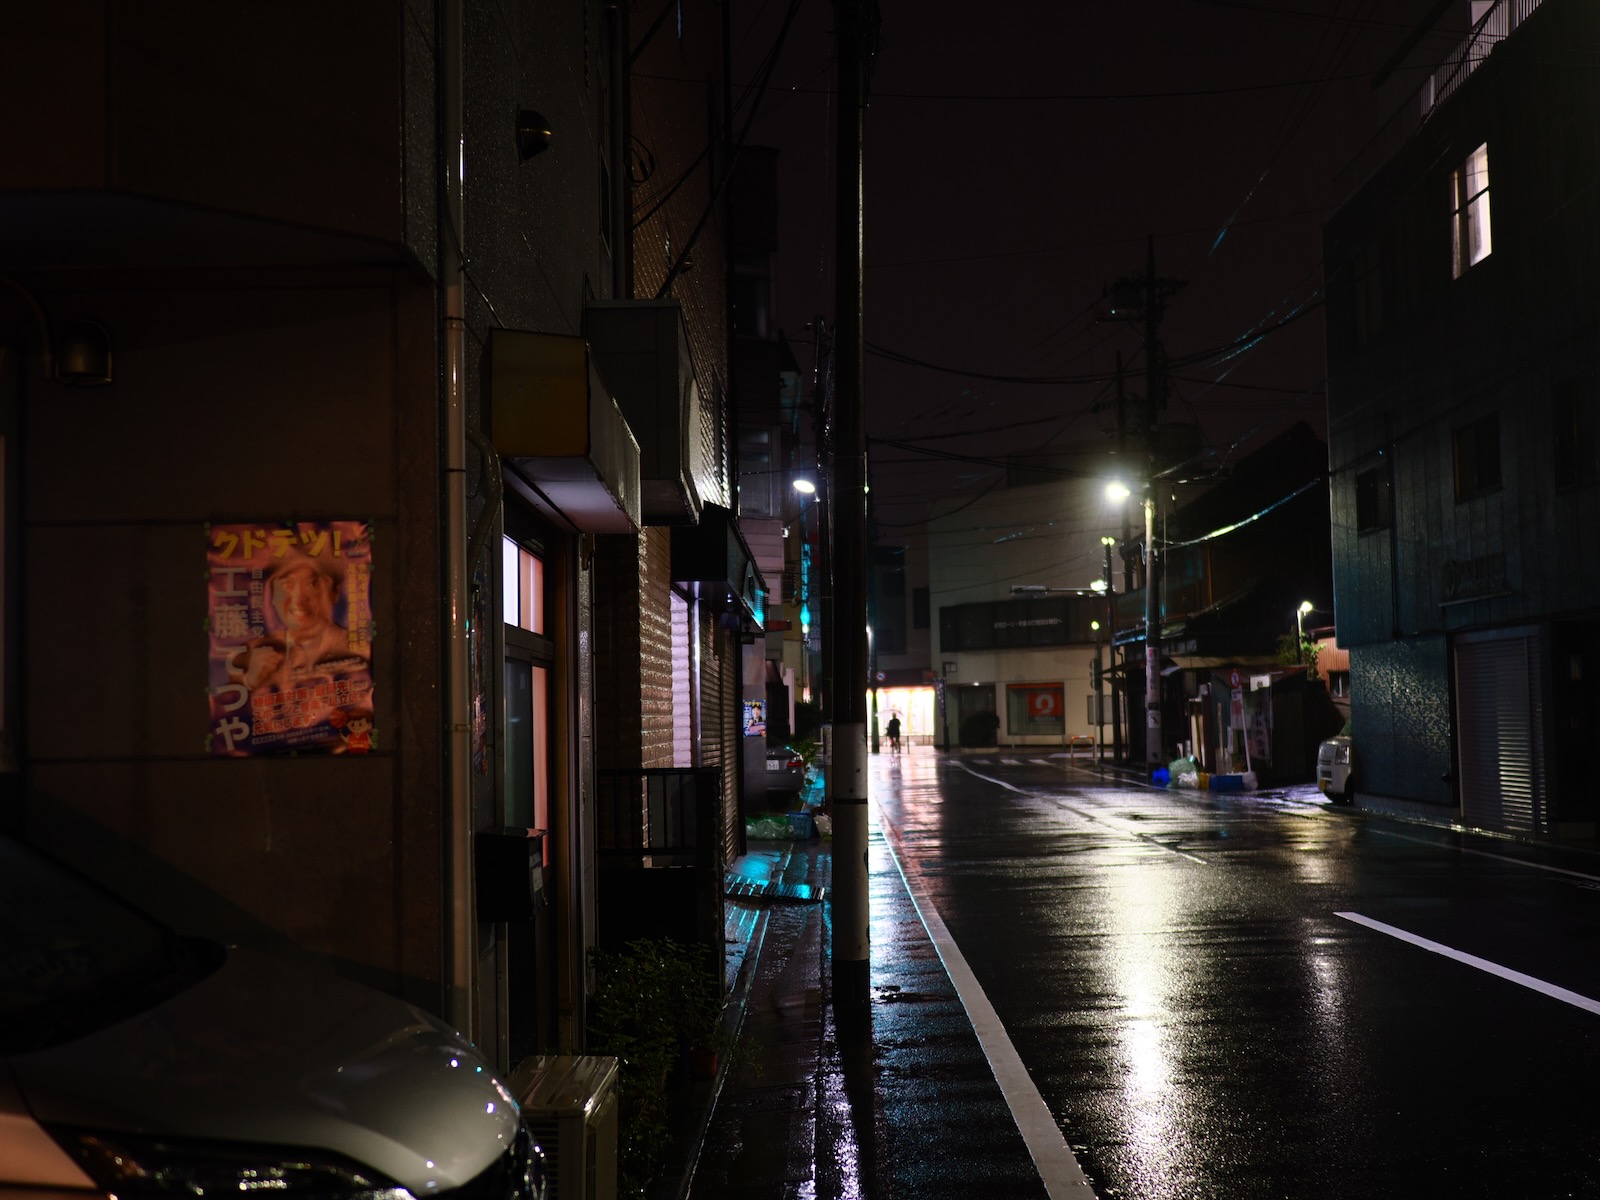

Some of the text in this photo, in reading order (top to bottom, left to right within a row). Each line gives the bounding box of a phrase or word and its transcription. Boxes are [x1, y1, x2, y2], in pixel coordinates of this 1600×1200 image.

[214, 529, 343, 559] クドテツ!
[251, 567, 265, 638] 自由民主党
[213, 567, 251, 751] 工藤てつや
